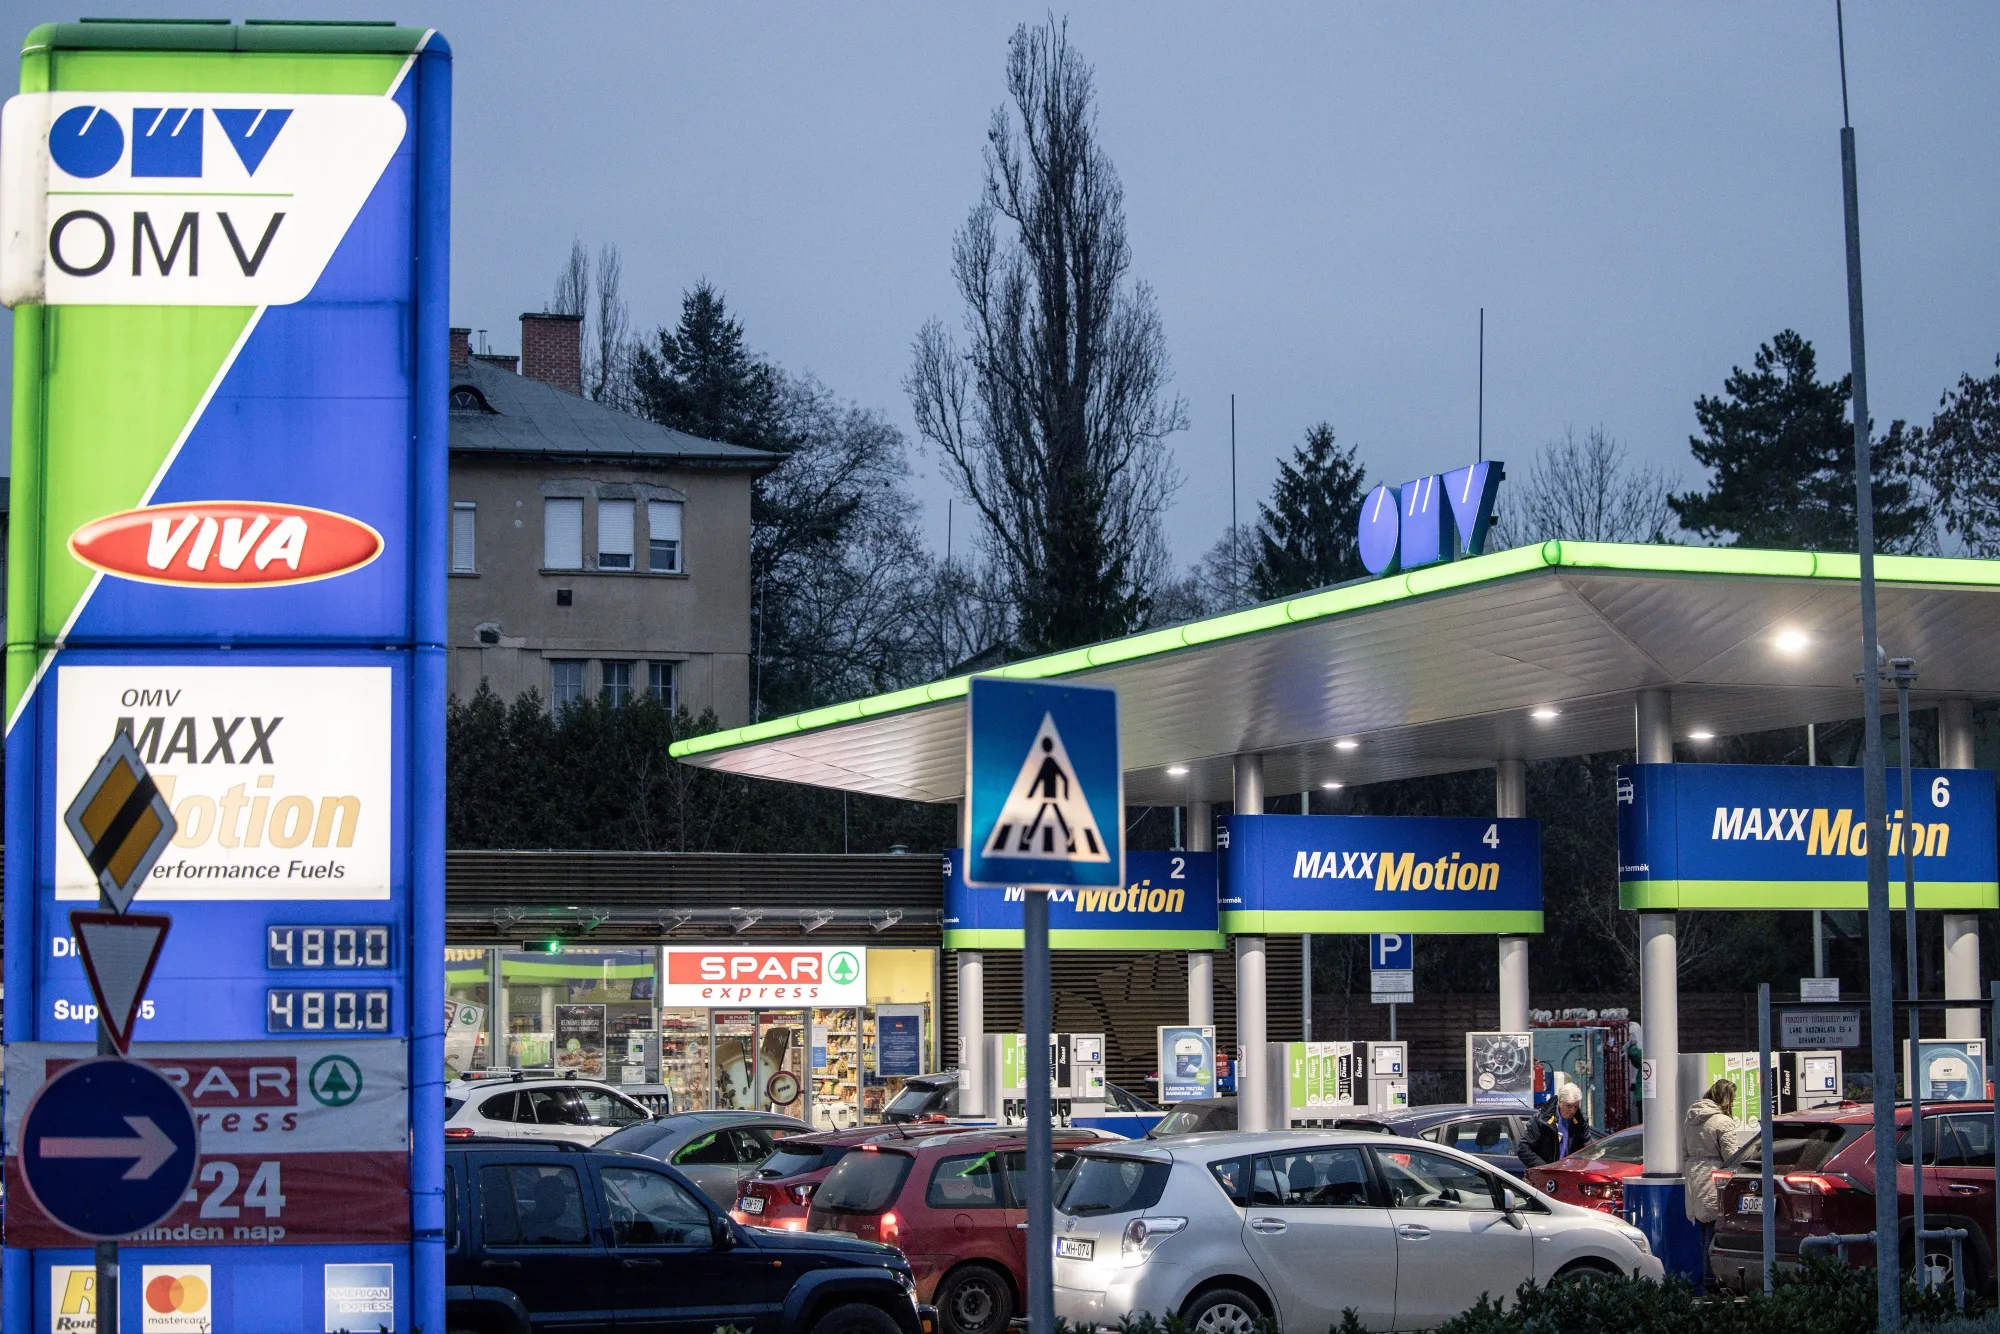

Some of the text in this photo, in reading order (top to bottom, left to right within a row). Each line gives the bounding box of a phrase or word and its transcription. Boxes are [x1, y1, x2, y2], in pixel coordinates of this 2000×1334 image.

[49, 210, 287, 277] OMV
[146, 513, 308, 571] VIVA
[121, 689, 182, 707] OMV
[113, 716, 285, 765] MAXX
[1931, 777, 1950, 807] 6
[151, 775, 361, 849] otion
[1482, 823, 1500, 849] 4
[153, 860, 345, 879] erformance Fuels
[1170, 857, 1186, 879] 2
[271, 928, 388, 967] 480,0
[1380, 934, 1403, 965] P
[700, 955, 820, 981] SPAR
[702, 984, 820, 1002] express
[271, 992, 388, 1030] 480,0
[159, 1066, 291, 1098] PAR
[1827, 1078, 1833, 1086] 6
[1743, 1198, 1763, 1210] SOG-
[233, 1225, 286, 1243] nap
[328, 1288, 388, 1298] AMERICAN
[341, 1302, 393, 1311] EXPRESS
[149, 1315, 207, 1325] mastercard
